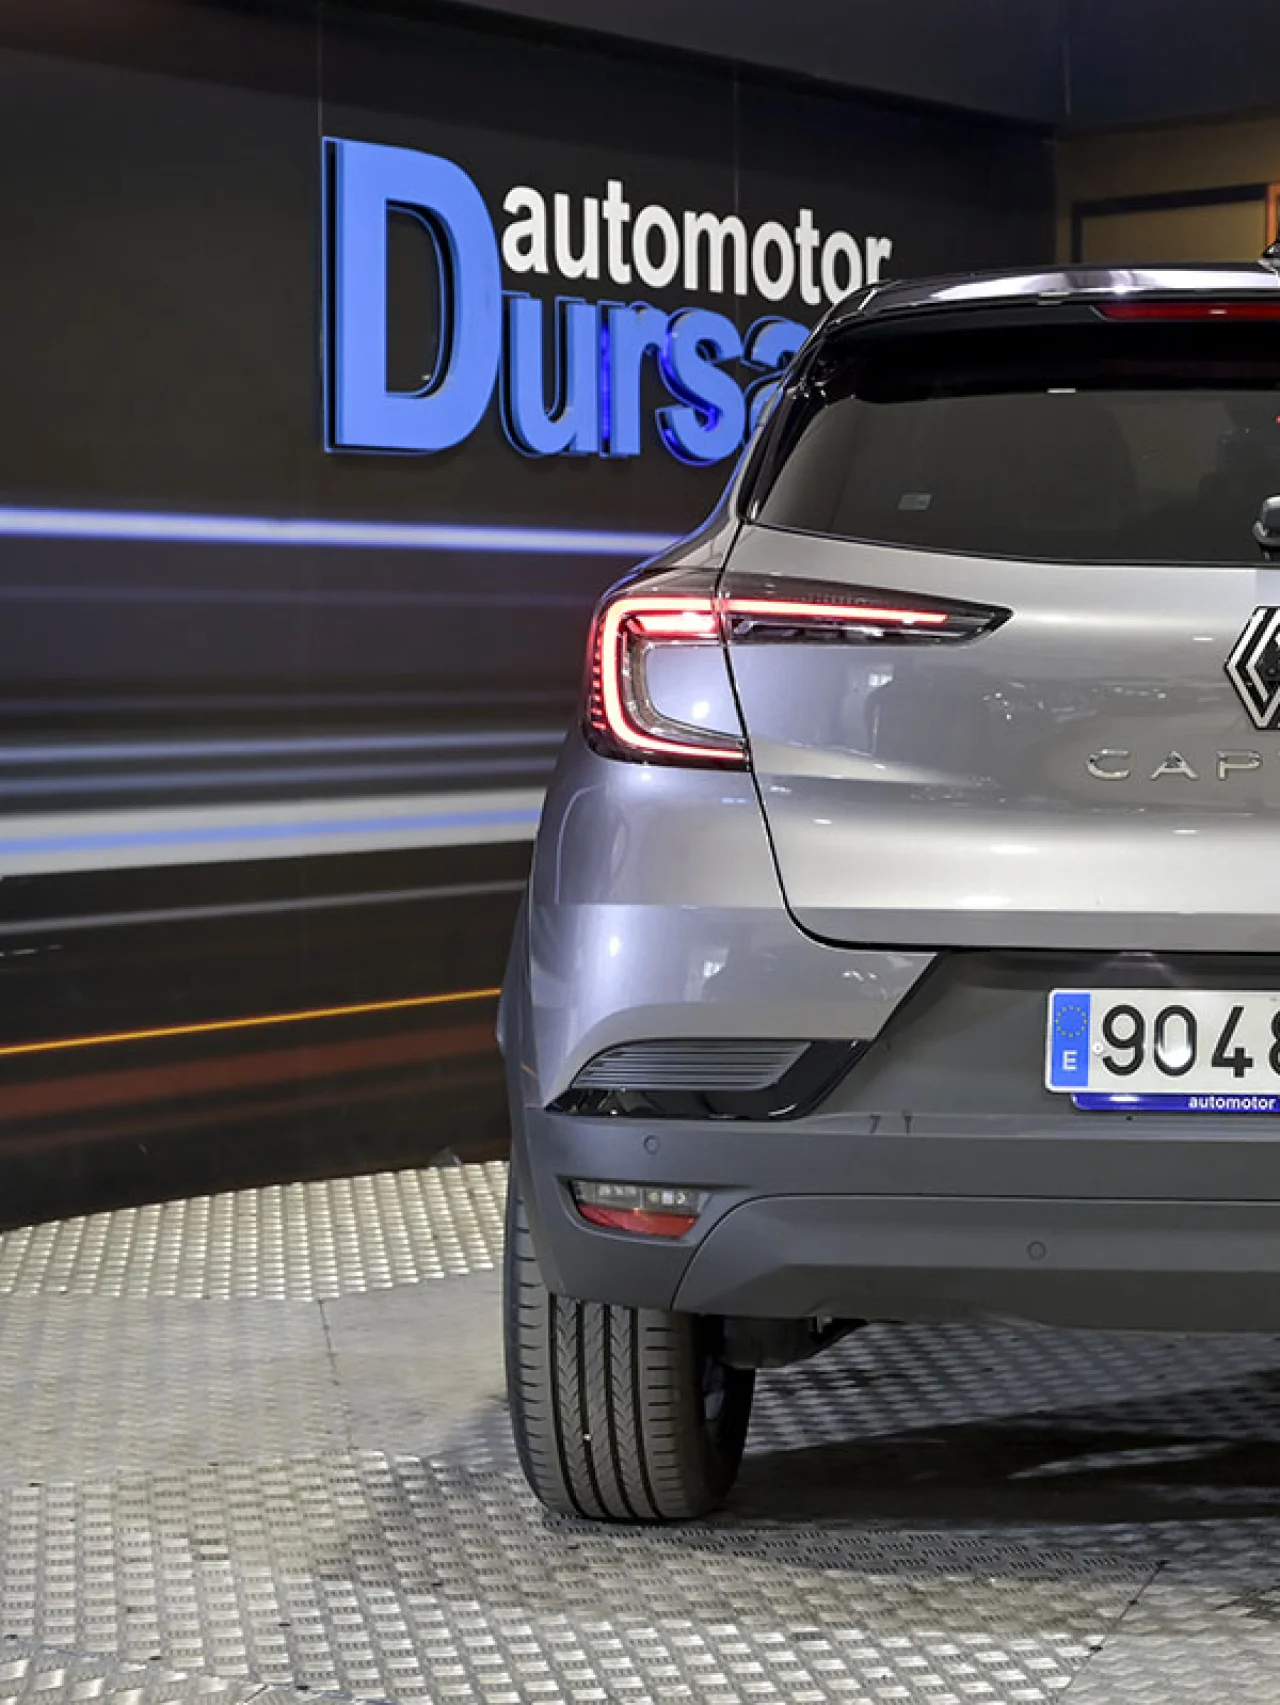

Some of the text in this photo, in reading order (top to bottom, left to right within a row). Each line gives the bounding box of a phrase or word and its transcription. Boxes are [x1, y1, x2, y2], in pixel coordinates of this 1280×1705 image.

[502, 180, 893, 305] automotor
[1062, 1050, 1078, 1070] E
[1188, 1096, 1275, 1110] automotor
